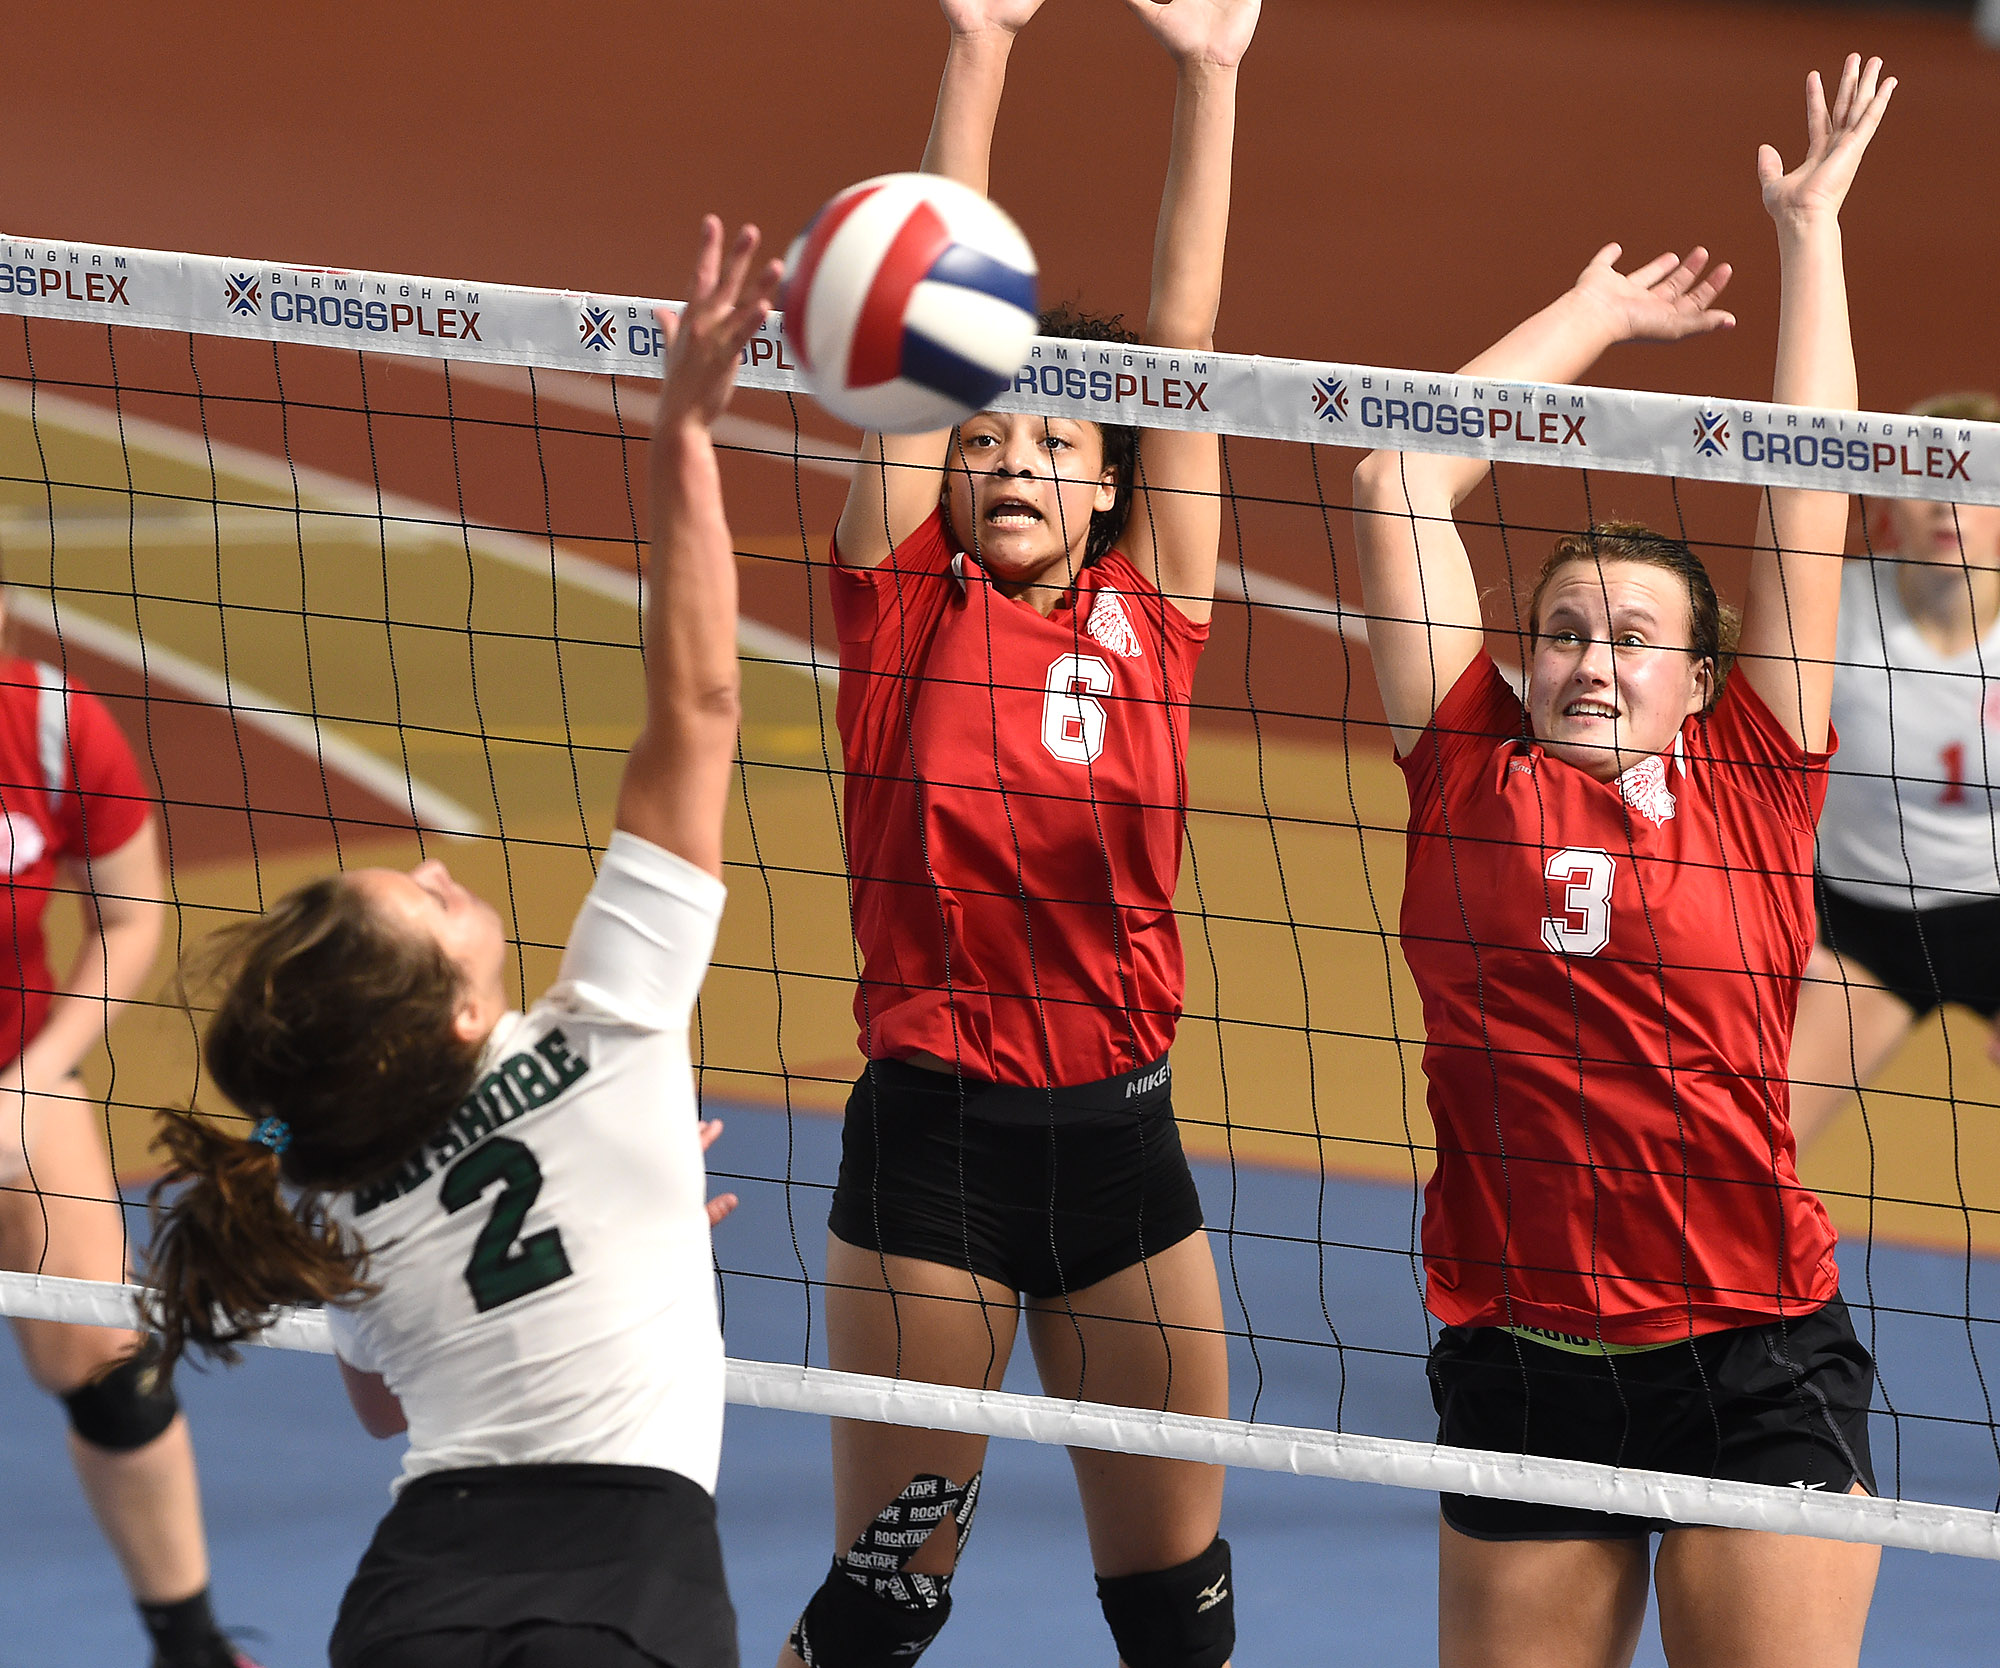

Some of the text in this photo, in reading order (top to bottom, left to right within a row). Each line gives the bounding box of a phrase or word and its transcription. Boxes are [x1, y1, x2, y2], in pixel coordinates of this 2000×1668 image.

[8, 246, 127, 268] INGHAM
[0, 263, 130, 306] SSPLEX
[271, 273, 479, 304] BIRMINGHAM
[271, 291, 482, 341] CROSSPLEX
[1031, 346, 1207, 374] RMINGHAM
[1002, 364, 1209, 411] ROSSPLEX
[1362, 377, 1584, 408] BIRMINGHAM
[1361, 396, 1587, 446] CROSSPLEX
[1743, 410, 1971, 442] BIRMINGHAM
[1742, 430, 1970, 481] CROSSPLEX
[1041, 652, 1114, 766] 6
[1938, 741, 1967, 806] 1
[1540, 845, 1617, 957] 3
[1125, 1065, 1167, 1099] NIKE
[439, 1136, 574, 1313] 2
